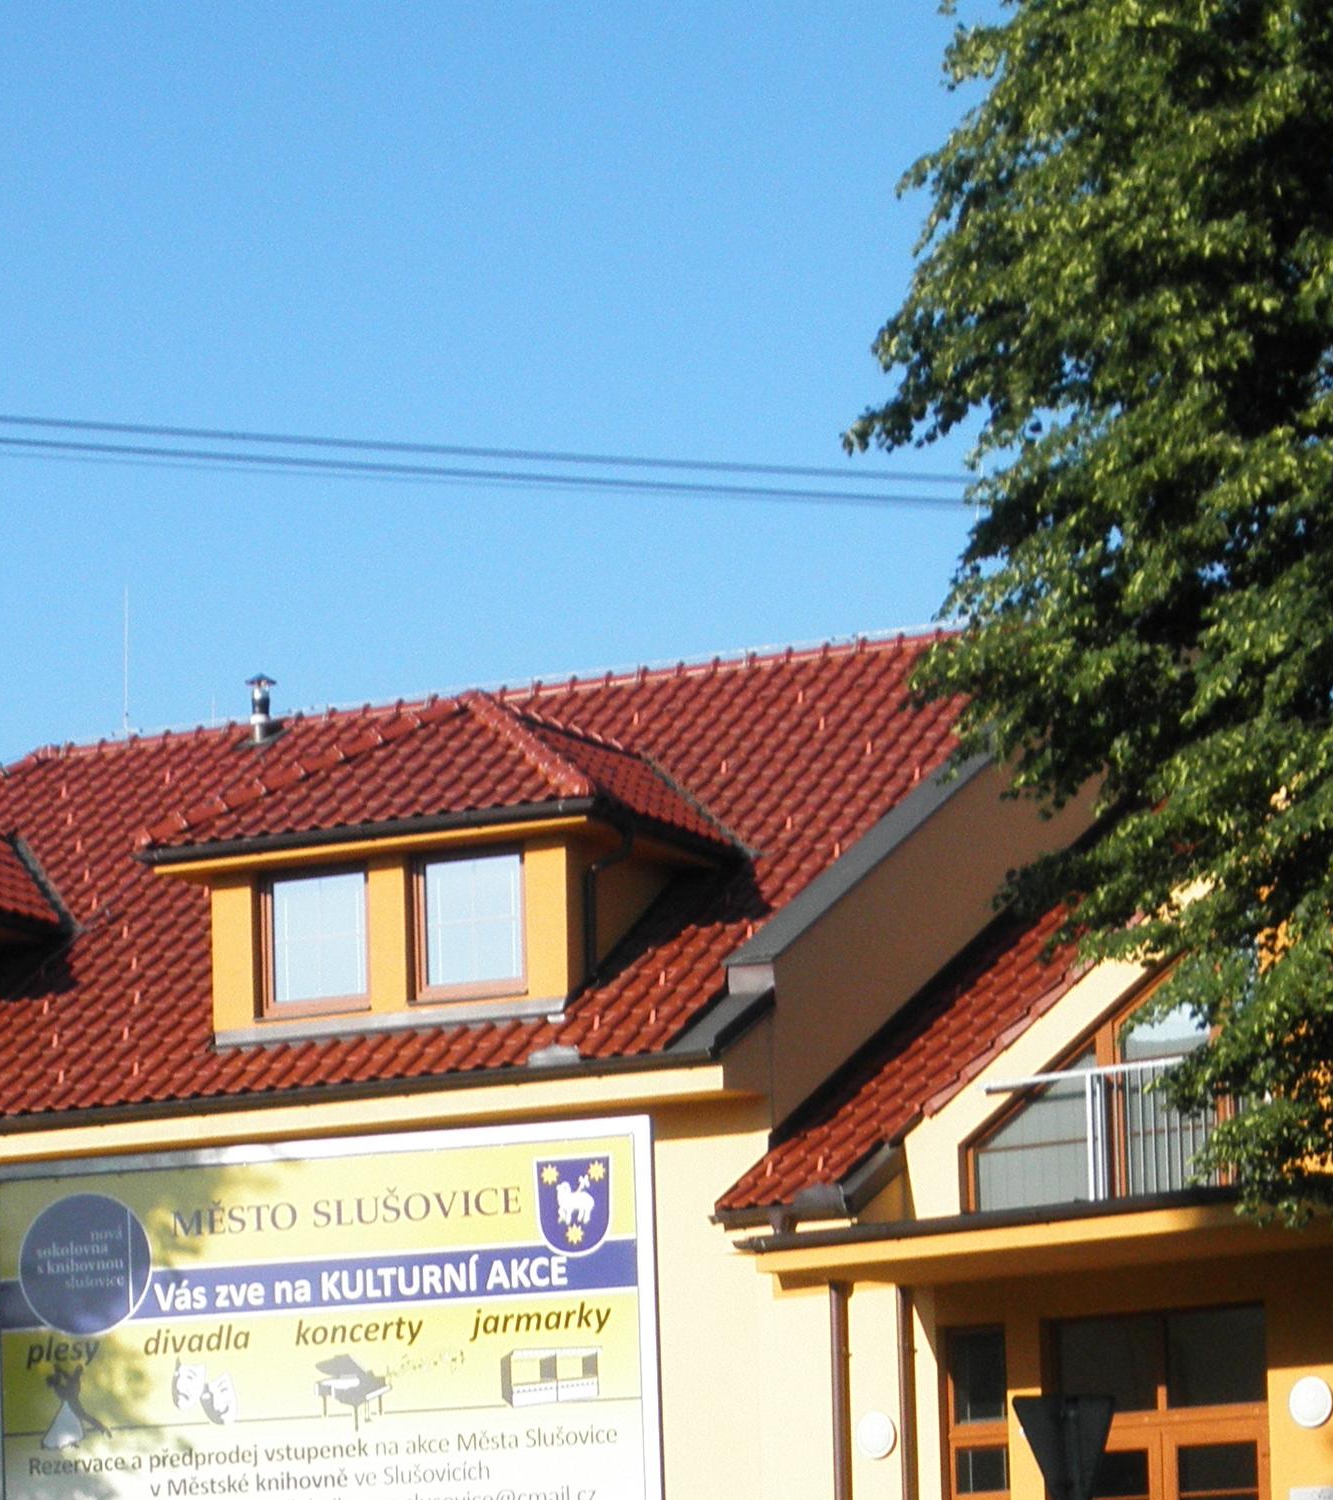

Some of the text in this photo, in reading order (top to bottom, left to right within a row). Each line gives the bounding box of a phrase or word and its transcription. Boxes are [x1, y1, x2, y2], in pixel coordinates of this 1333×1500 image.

[170, 1186, 522, 1240] MĚSTO SLUŠOVICE
[36, 1240, 109, 1259] sokolovna
[46, 1257, 125, 1276] knihovnou
[154, 1253, 569, 1312] Vás zve na KULTURNÍ AKCE
[26, 1301, 612, 1370] plesy divadla koncerty jarmarky
[28, 1424, 618, 1477] Rezervace a předprodej vstupenek na akce Města Slušovice
[150, 1459, 491, 1498] v Městské knihovně ve Slušovicích
